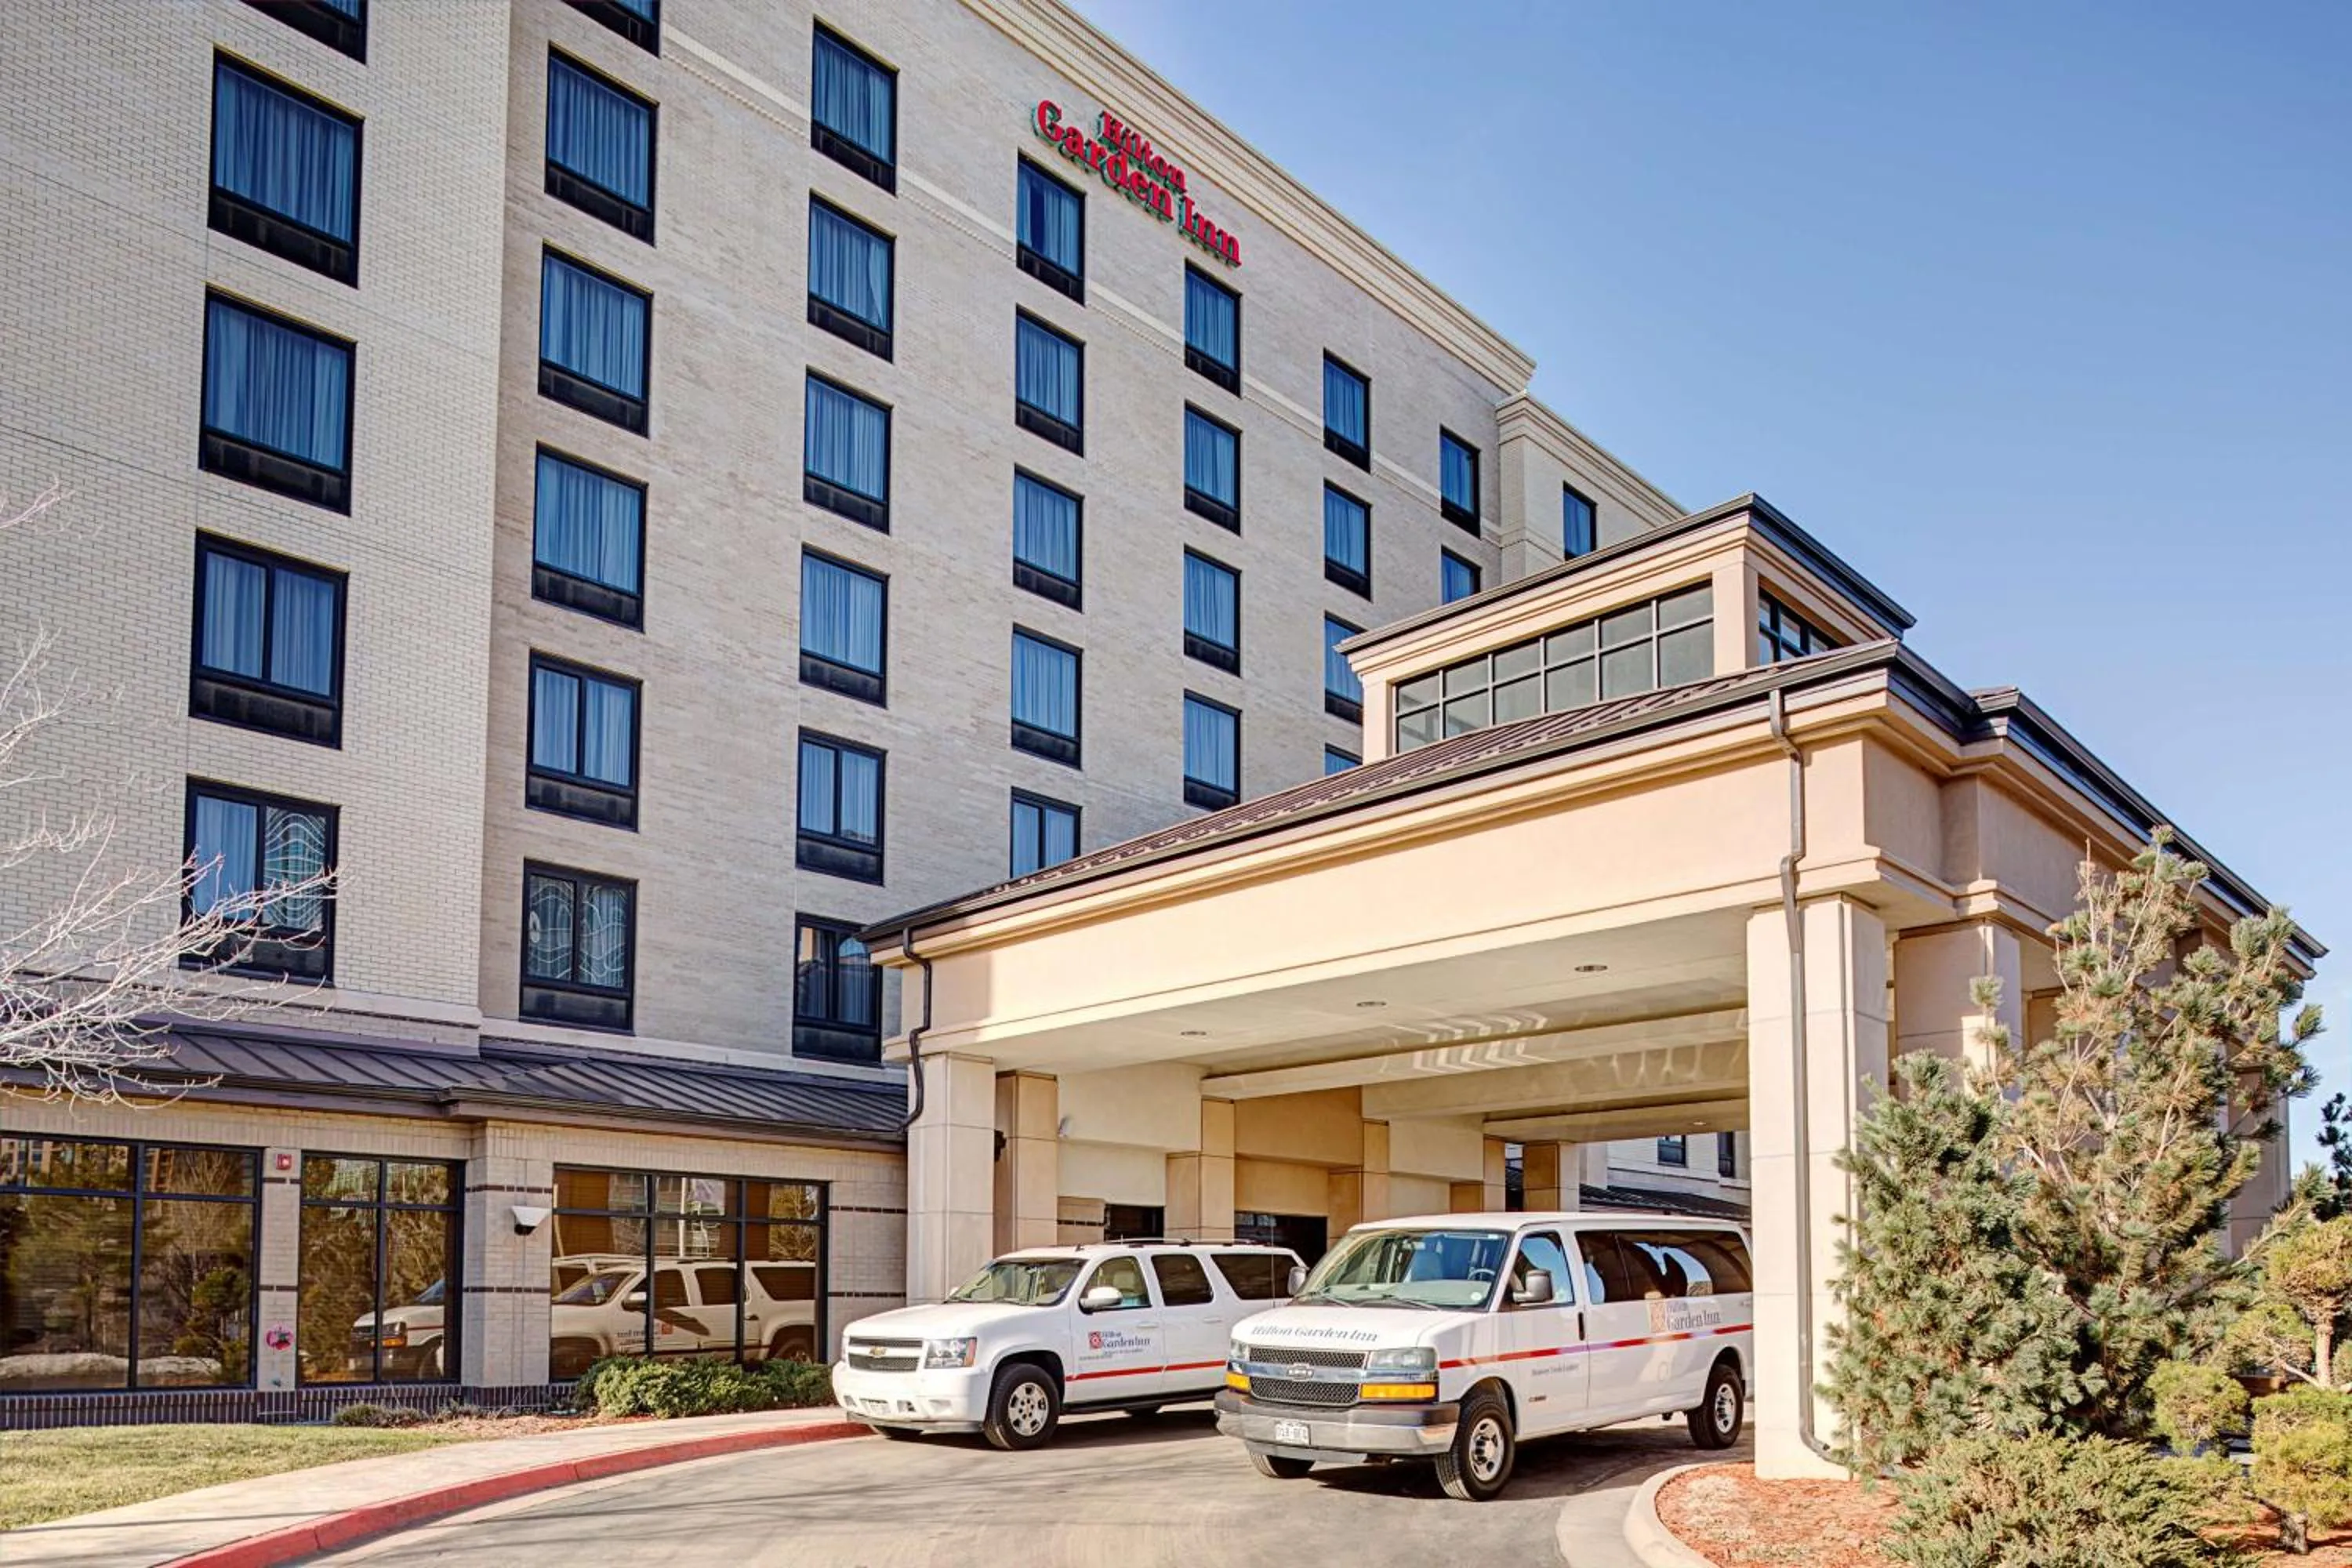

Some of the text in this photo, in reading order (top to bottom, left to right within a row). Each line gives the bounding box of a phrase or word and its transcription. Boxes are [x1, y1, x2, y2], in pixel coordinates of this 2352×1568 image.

[1098, 110, 1187, 193] Hilton
[1033, 100, 1242, 268] Garden Inn
[1294, 1327, 1348, 1339] Garden
[1348, 1329, 1378, 1342] Inn
[1667, 1313, 1704, 1330] Garden
